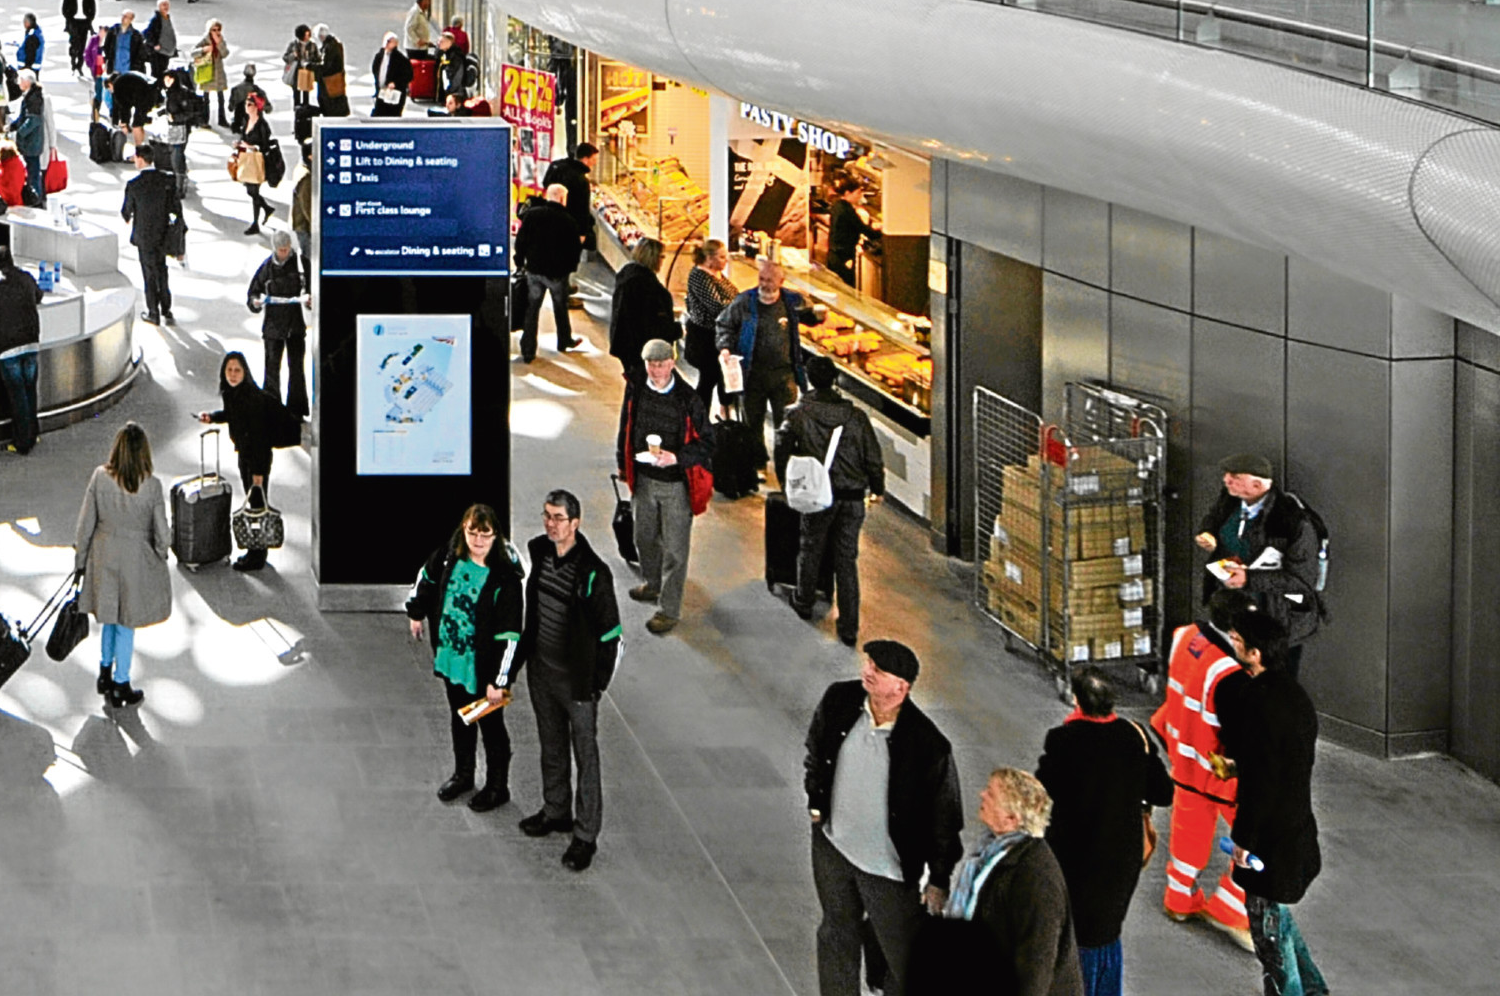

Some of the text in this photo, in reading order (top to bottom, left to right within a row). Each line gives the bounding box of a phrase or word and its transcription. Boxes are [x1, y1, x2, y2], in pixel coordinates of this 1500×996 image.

[504, 67, 553, 110] 25%
[740, 102, 850, 159] PASTY SHOP
[355, 140, 414, 152] Underground
[355, 156, 458, 168] Lift to Dining & seating
[355, 173, 379, 182] Taxis
[356, 205, 432, 217] First class lounge
[401, 246, 430, 258] Dining
[432, 246, 440, 255] &
[441, 246, 475, 258] seating
